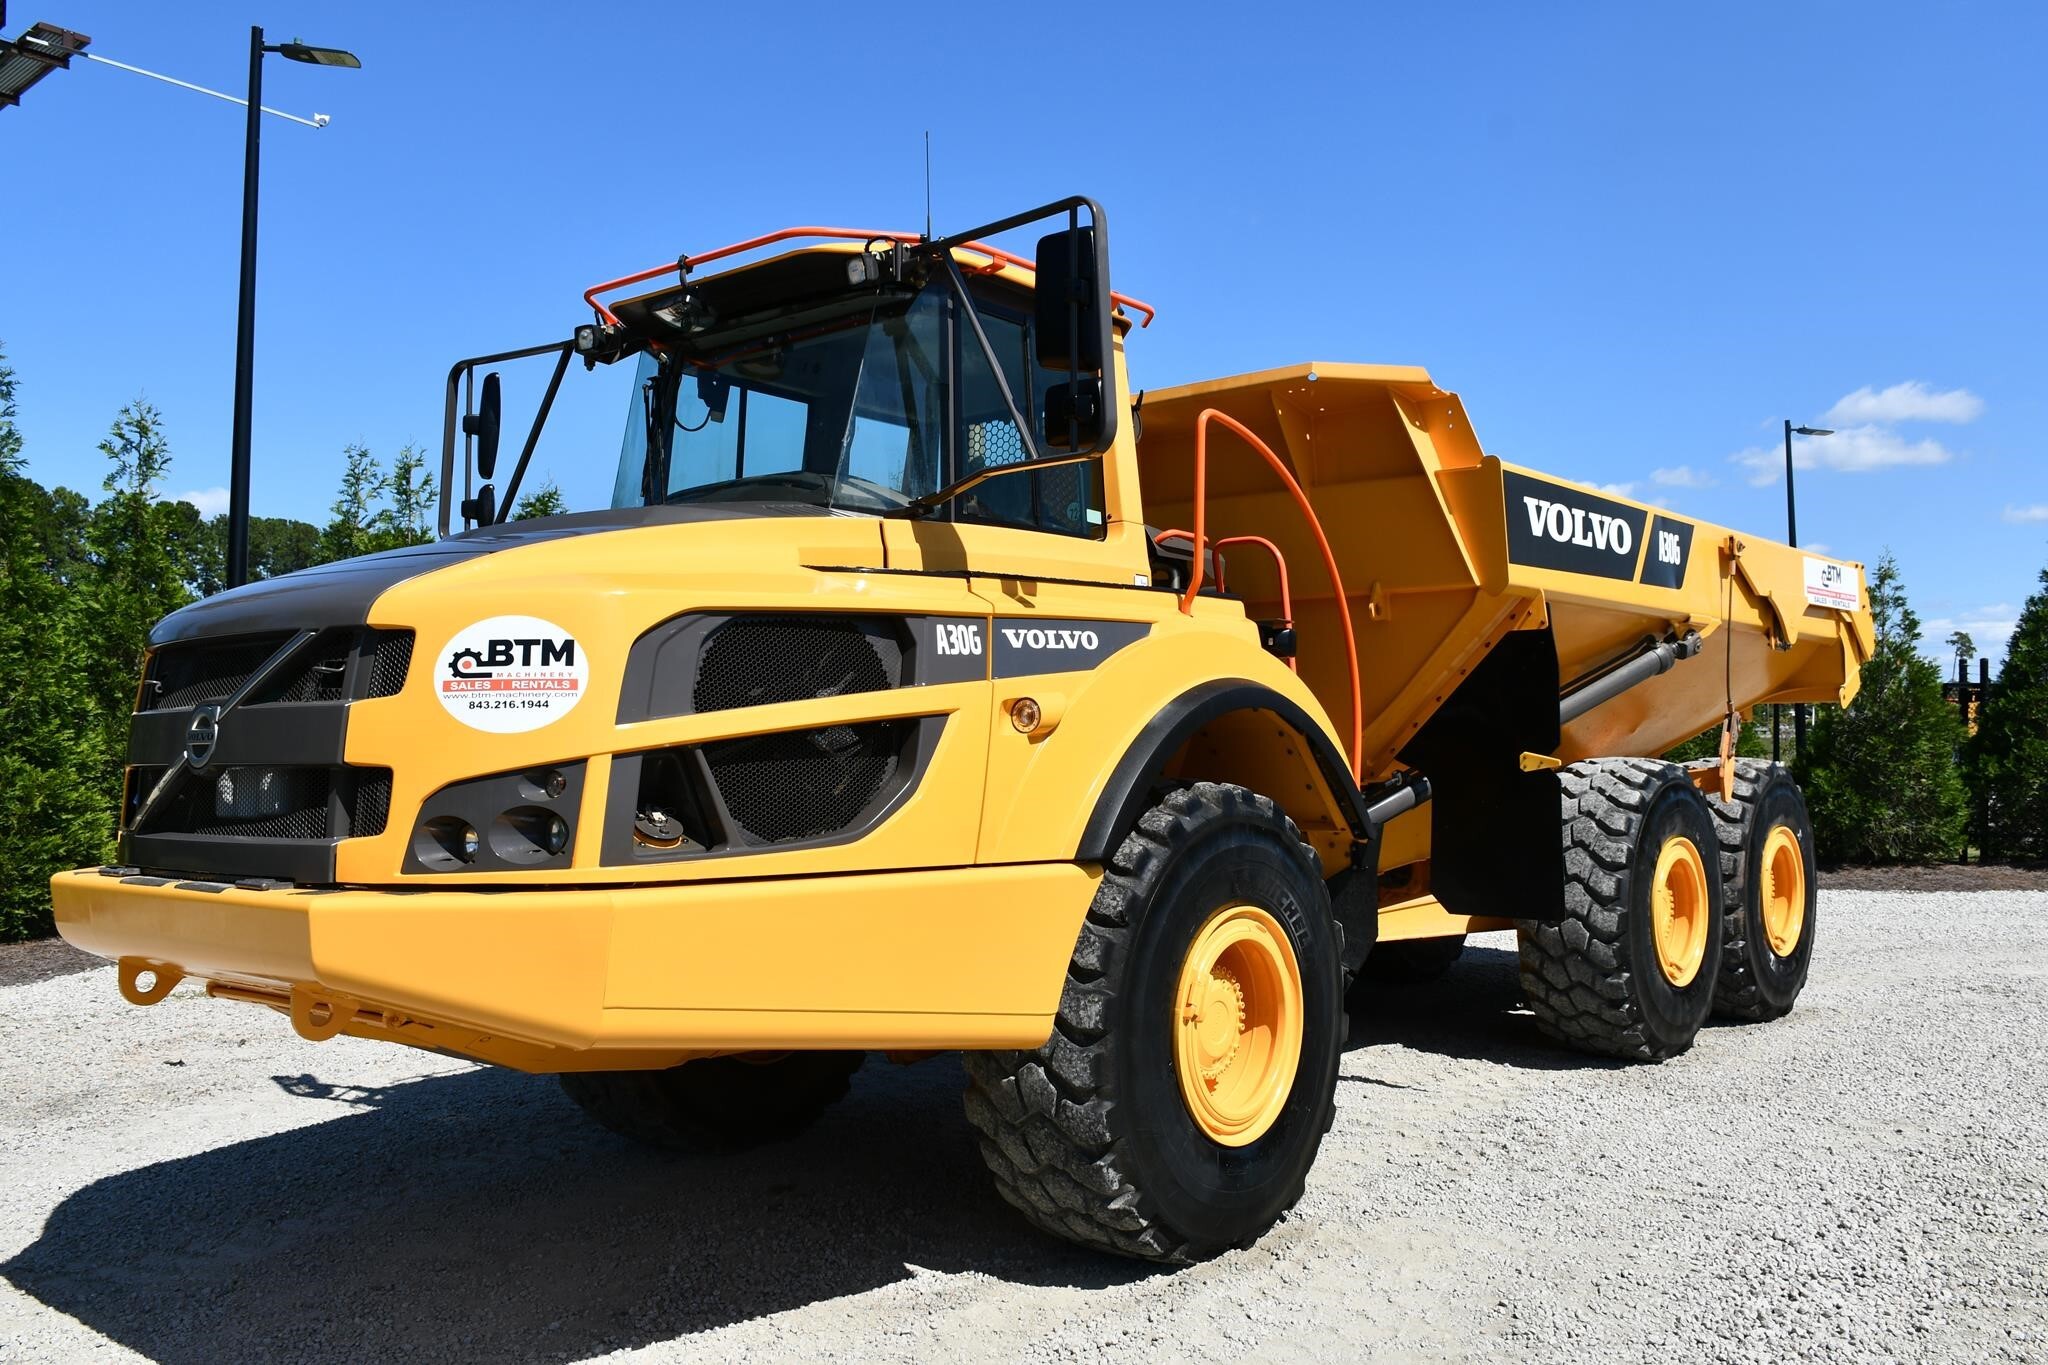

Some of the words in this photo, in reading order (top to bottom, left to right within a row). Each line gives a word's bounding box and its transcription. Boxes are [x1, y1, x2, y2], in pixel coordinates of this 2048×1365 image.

[1523, 496, 1632, 555] VOLVO
[1658, 530, 1681, 566] A30G
[1827, 564, 1842, 584] BTM
[936, 624, 982, 655] A30G
[1002, 629, 1099, 651] VOLVO
[487, 639, 575, 666] BTM
[443, 691, 578, 700] www.btm-machinery.com
[450, 681, 491, 690] SALES
[511, 680, 571, 689] RENTALS
[468, 700, 550, 709] 843.216.1944
